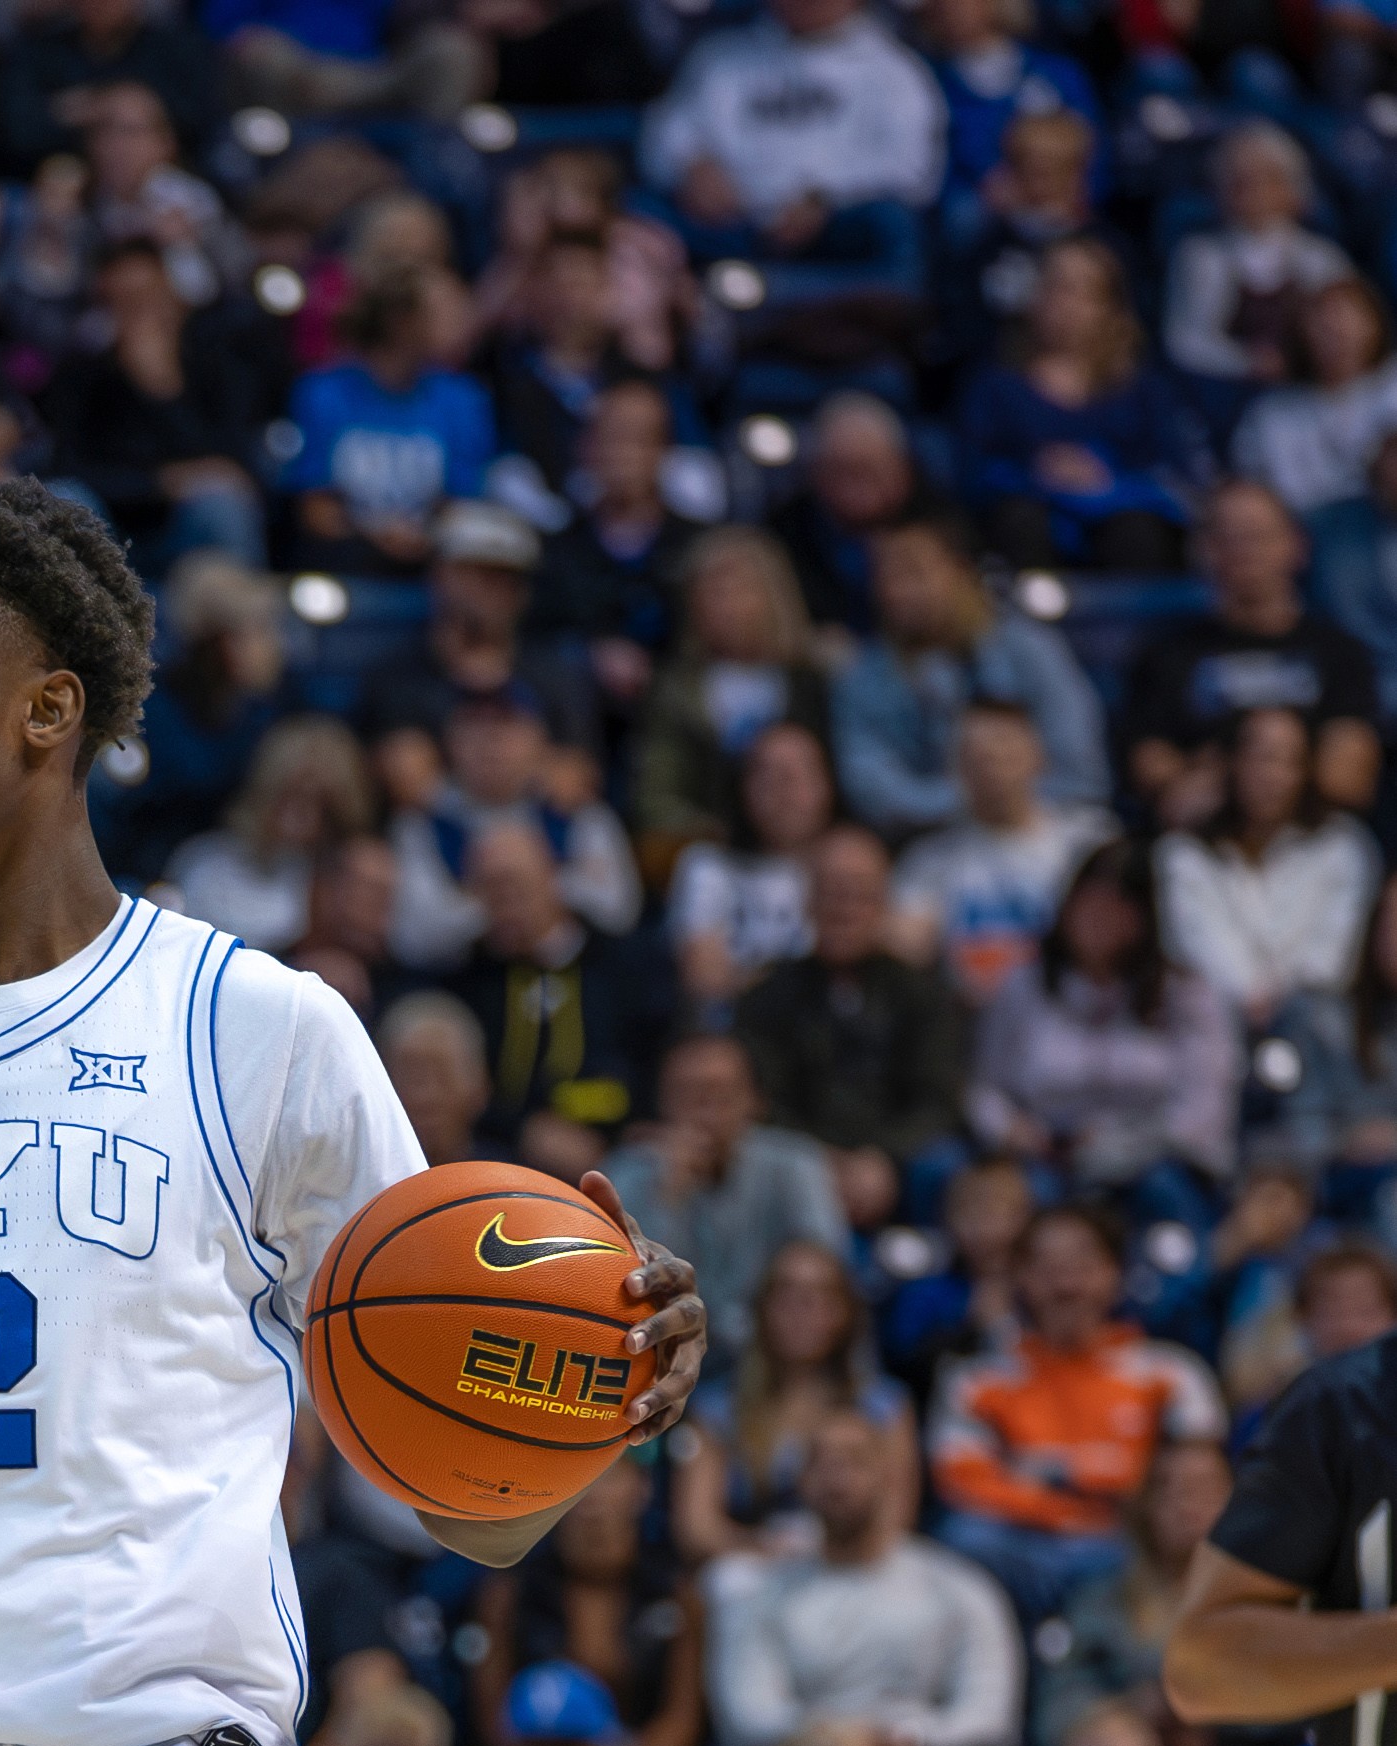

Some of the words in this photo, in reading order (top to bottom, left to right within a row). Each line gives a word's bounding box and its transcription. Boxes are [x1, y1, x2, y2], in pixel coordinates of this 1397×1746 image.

[68, 1046, 148, 1094] XII
[461, 1329, 631, 1406] ELITE
[456, 1379, 619, 1421] CHAMPIONSHIP
